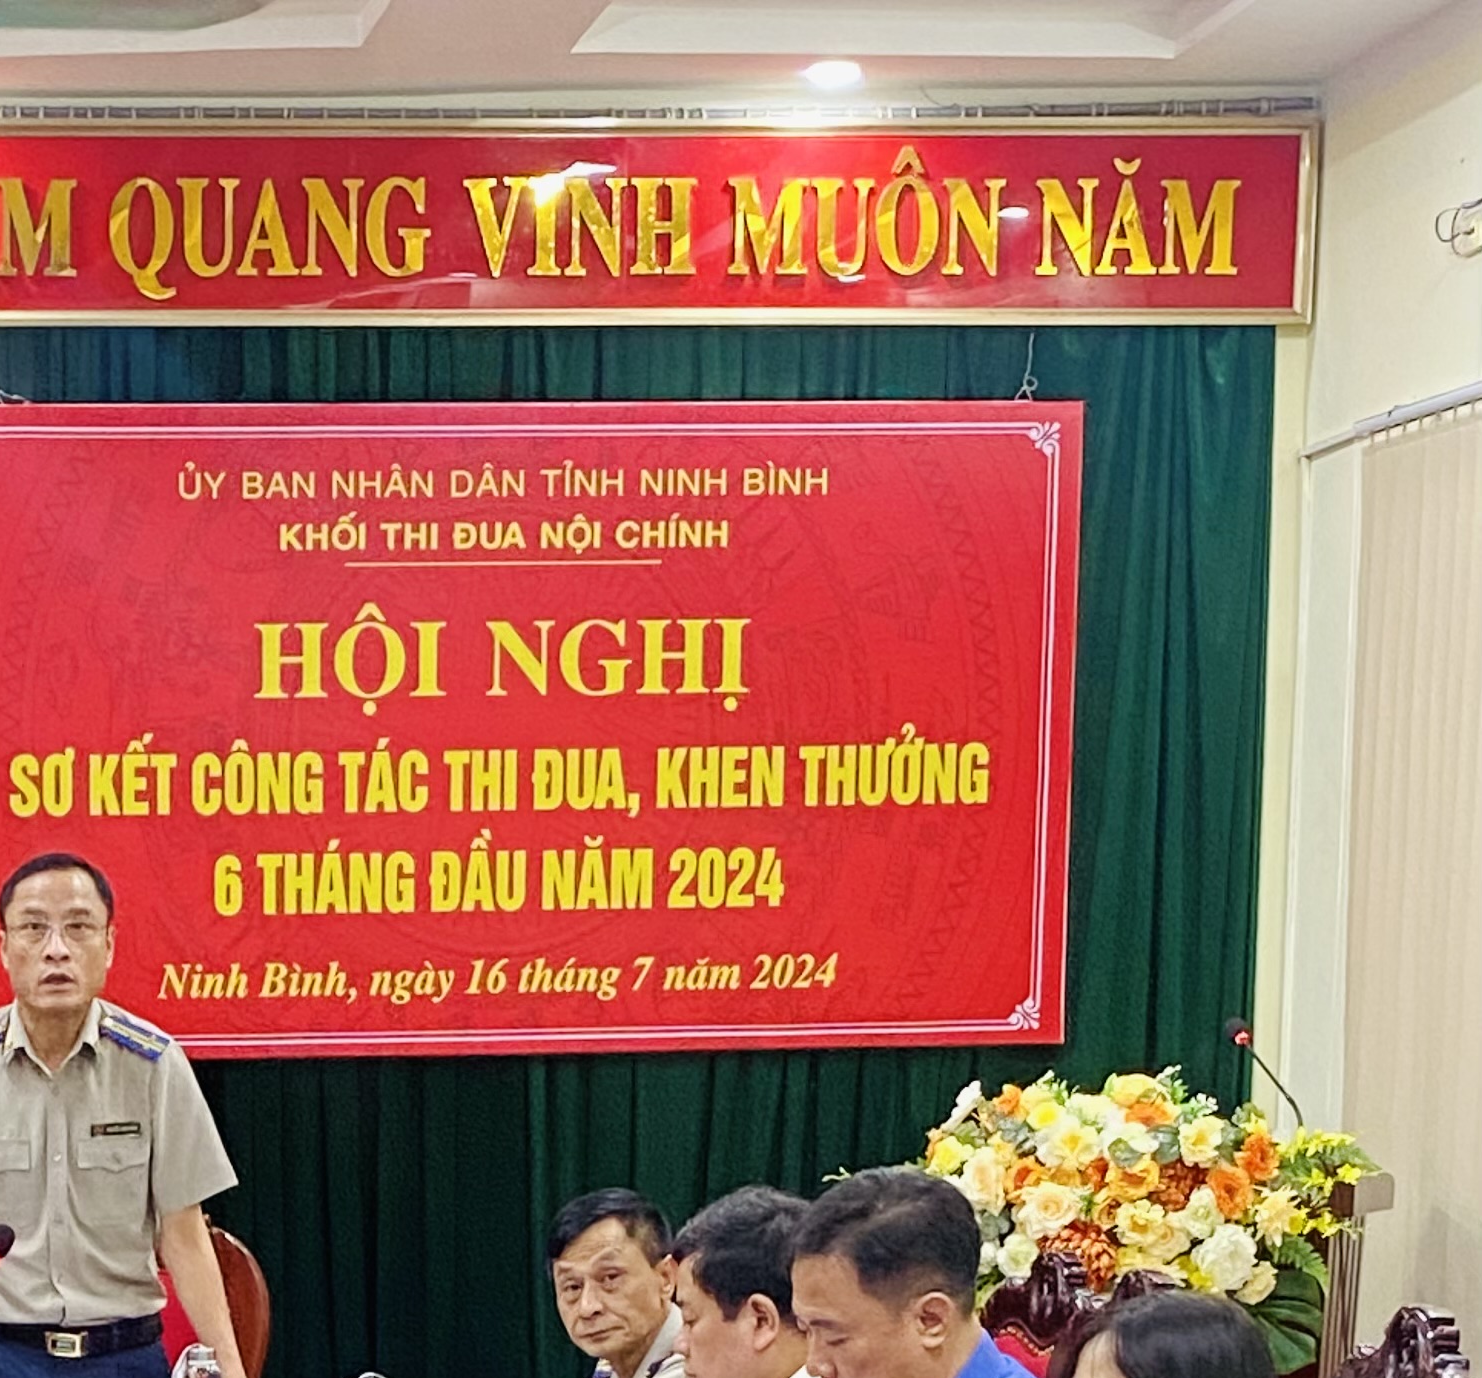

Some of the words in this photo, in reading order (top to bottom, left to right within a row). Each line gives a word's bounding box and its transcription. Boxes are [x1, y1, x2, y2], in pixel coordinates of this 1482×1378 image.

[108, 176, 431, 300] QUANG
[462, 175, 699, 278] VINH
[727, 145, 1007, 279] MUÔN
[1034, 157, 1241, 277] NĂM
[178, 461, 226, 500] ỦY
[241, 471, 316, 500] BAN
[331, 463, 434, 500] NHÂN
[450, 462, 525, 498] DÂN
[539, 459, 624, 498] TỈNH
[640, 468, 728, 497] NINH
[742, 460, 829, 496] BÌNH
[279, 511, 367, 552] KHỐI
[379, 522, 439, 552] THI
[452, 521, 526, 551] ĐUA
[540, 513, 601, 555] NỘI
[615, 512, 730, 550] CHÍNH
[253, 601, 448, 717] HỘI
[485, 617, 753, 713] NGHỊ
[8, 746, 75, 818] SƠ
[88, 732, 178, 816] KẾT
[191, 738, 325, 816] CÔNG
[338, 737, 430, 815] TÁC
[443, 748, 518, 813] THI
[531, 747, 641, 818] ĐUA,
[655, 745, 785, 810] KHEN
[799, 722, 990, 809] THƯỞNG
[213, 854, 244, 917] 6
[256, 838, 416, 916] THÁNG
[429, 828, 528, 914] ĐẦU
[541, 834, 654, 912] NĂM
[667, 846, 785, 910] 2024
[157, 962, 249, 1000] Ninh
[260, 961, 358, 1004] Bình,
[369, 959, 455, 1005] ngày
[466, 958, 508, 996] 16
[518, 954, 622, 1001] tháng
[632, 956, 655, 992] 7
[663, 954, 742, 991] năm
[749, 952, 840, 990] 2024
